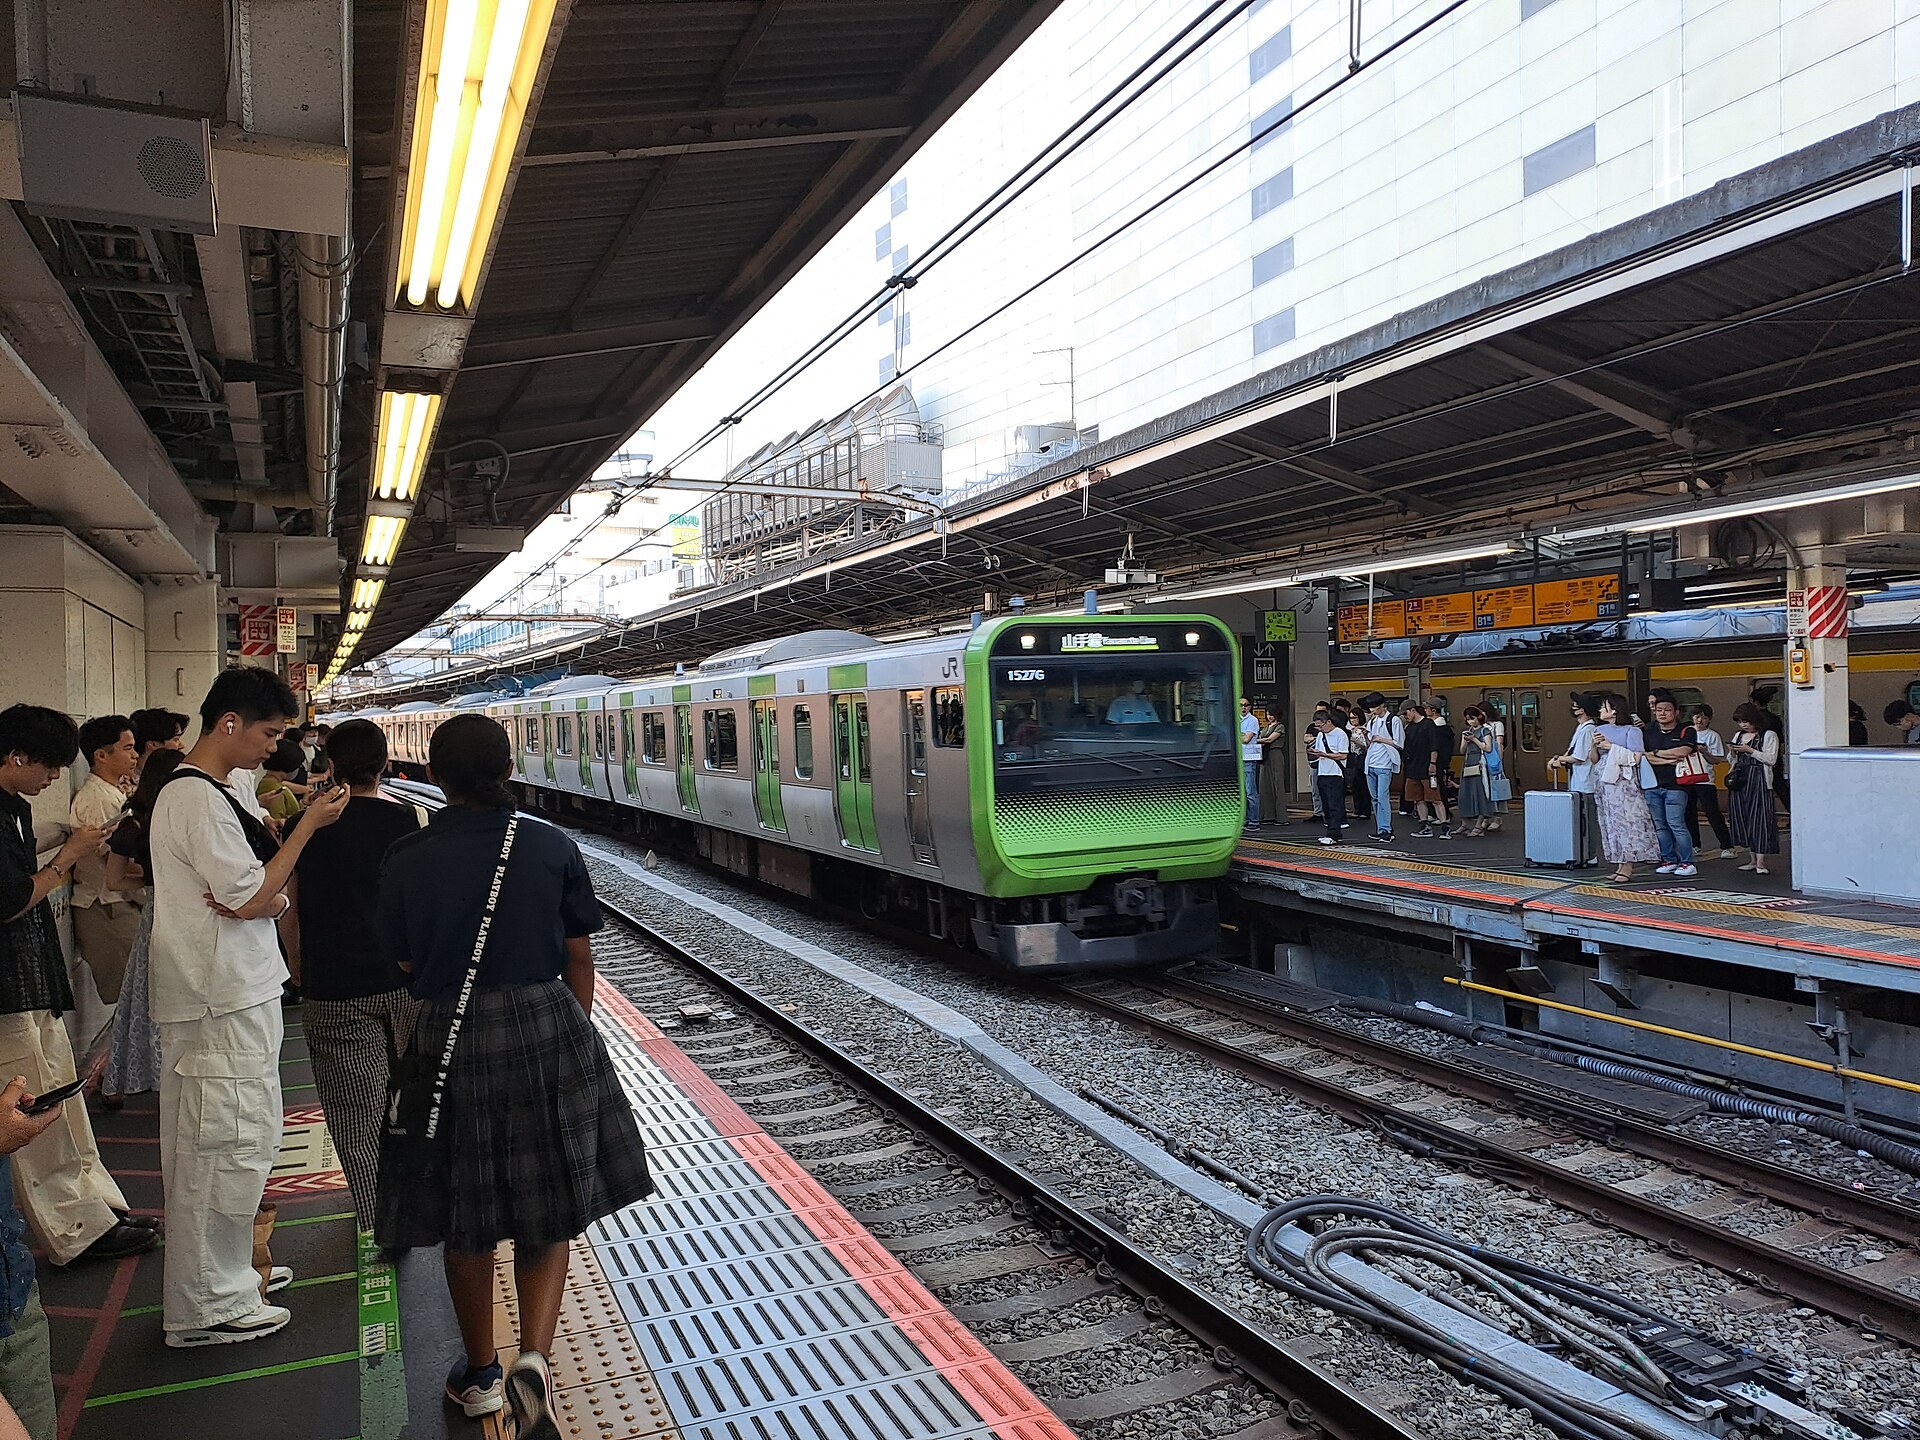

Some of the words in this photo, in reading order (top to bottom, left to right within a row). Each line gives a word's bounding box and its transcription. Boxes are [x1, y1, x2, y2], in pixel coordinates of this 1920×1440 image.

[942, 657, 958, 678] JR
[1007, 669, 1045, 681] 1527G
[500, 819, 517, 860] PLAYBOY
[486, 865, 505, 911] PLAYBOY
[471, 916, 492, 963] PLAYBOY
[456, 968, 477, 1015] PLAYBOY
